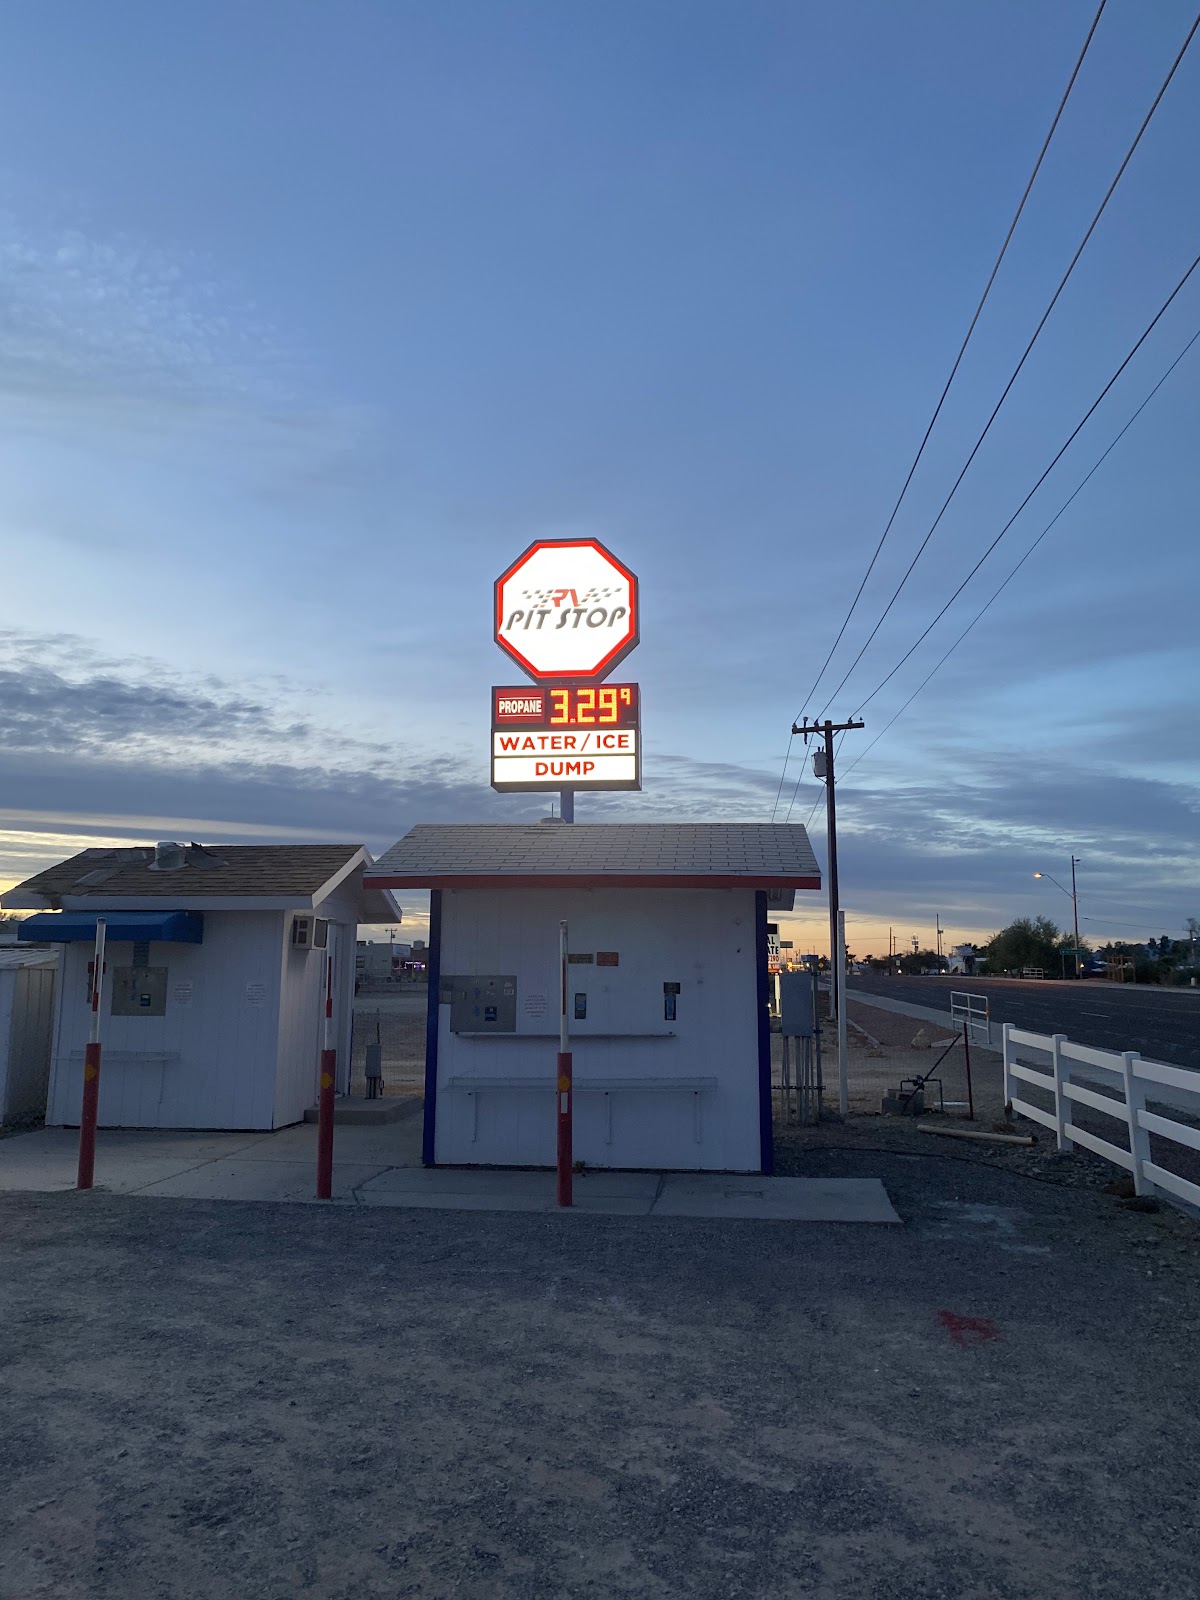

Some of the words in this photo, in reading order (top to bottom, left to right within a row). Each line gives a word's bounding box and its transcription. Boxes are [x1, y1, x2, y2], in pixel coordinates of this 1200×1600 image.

[505, 608, 552, 631] PIT
[555, 605, 627, 630] STOP
[498, 699, 543, 714] PROPANE
[535, 761, 595, 776] DUMP
